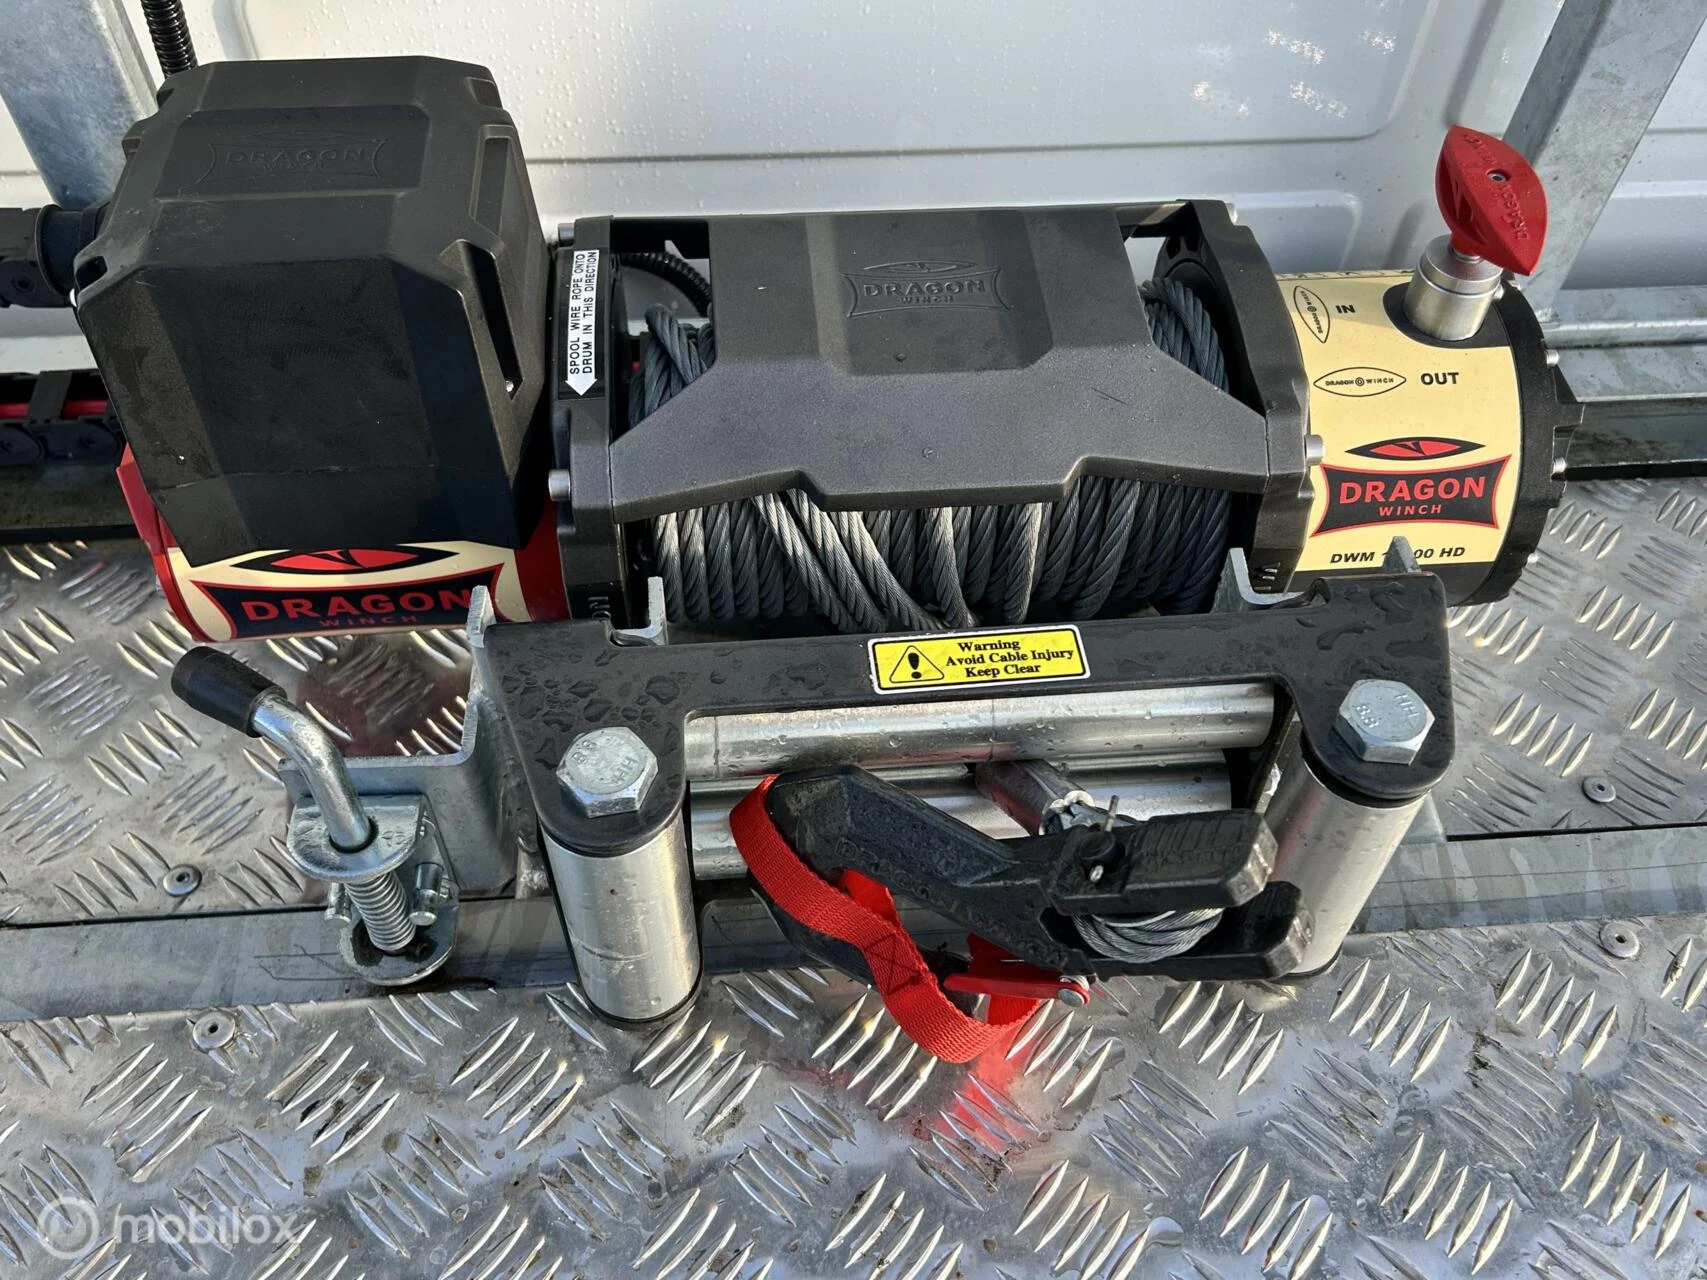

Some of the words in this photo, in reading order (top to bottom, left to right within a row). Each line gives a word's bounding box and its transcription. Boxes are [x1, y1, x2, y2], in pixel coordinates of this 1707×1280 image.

[574, 254, 585, 274] ONTO
[584, 251, 597, 292] DIRECTION
[572, 277, 583, 300] ROPE
[863, 279, 986, 297] DRAGON
[583, 297, 594, 318] THIS
[899, 296, 954, 305] WINCH
[1336, 304, 1356, 314] IN
[571, 305, 581, 331] WIRE
[583, 324, 592, 335] IN
[570, 337, 580, 375] SPOOL
[582, 341, 592, 374] DRUM
[1420, 372, 1459, 385] OUT
[1339, 476, 1486, 504] DRAGON
[1379, 504, 1442, 517] WINCH
[1330, 551, 1375, 564] DWM
[1439, 547, 1466, 558] HD
[240, 589, 471, 621] DRAGON
[318, 615, 418, 627] WINCH
[957, 639, 1021, 652] Warning
[945, 653, 985, 667] Avoid
[989, 650, 1028, 663] Cable
[1032, 648, 1074, 661] Injury
[965, 665, 1000, 679] Keep
[1004, 663, 1041, 675] Clear
